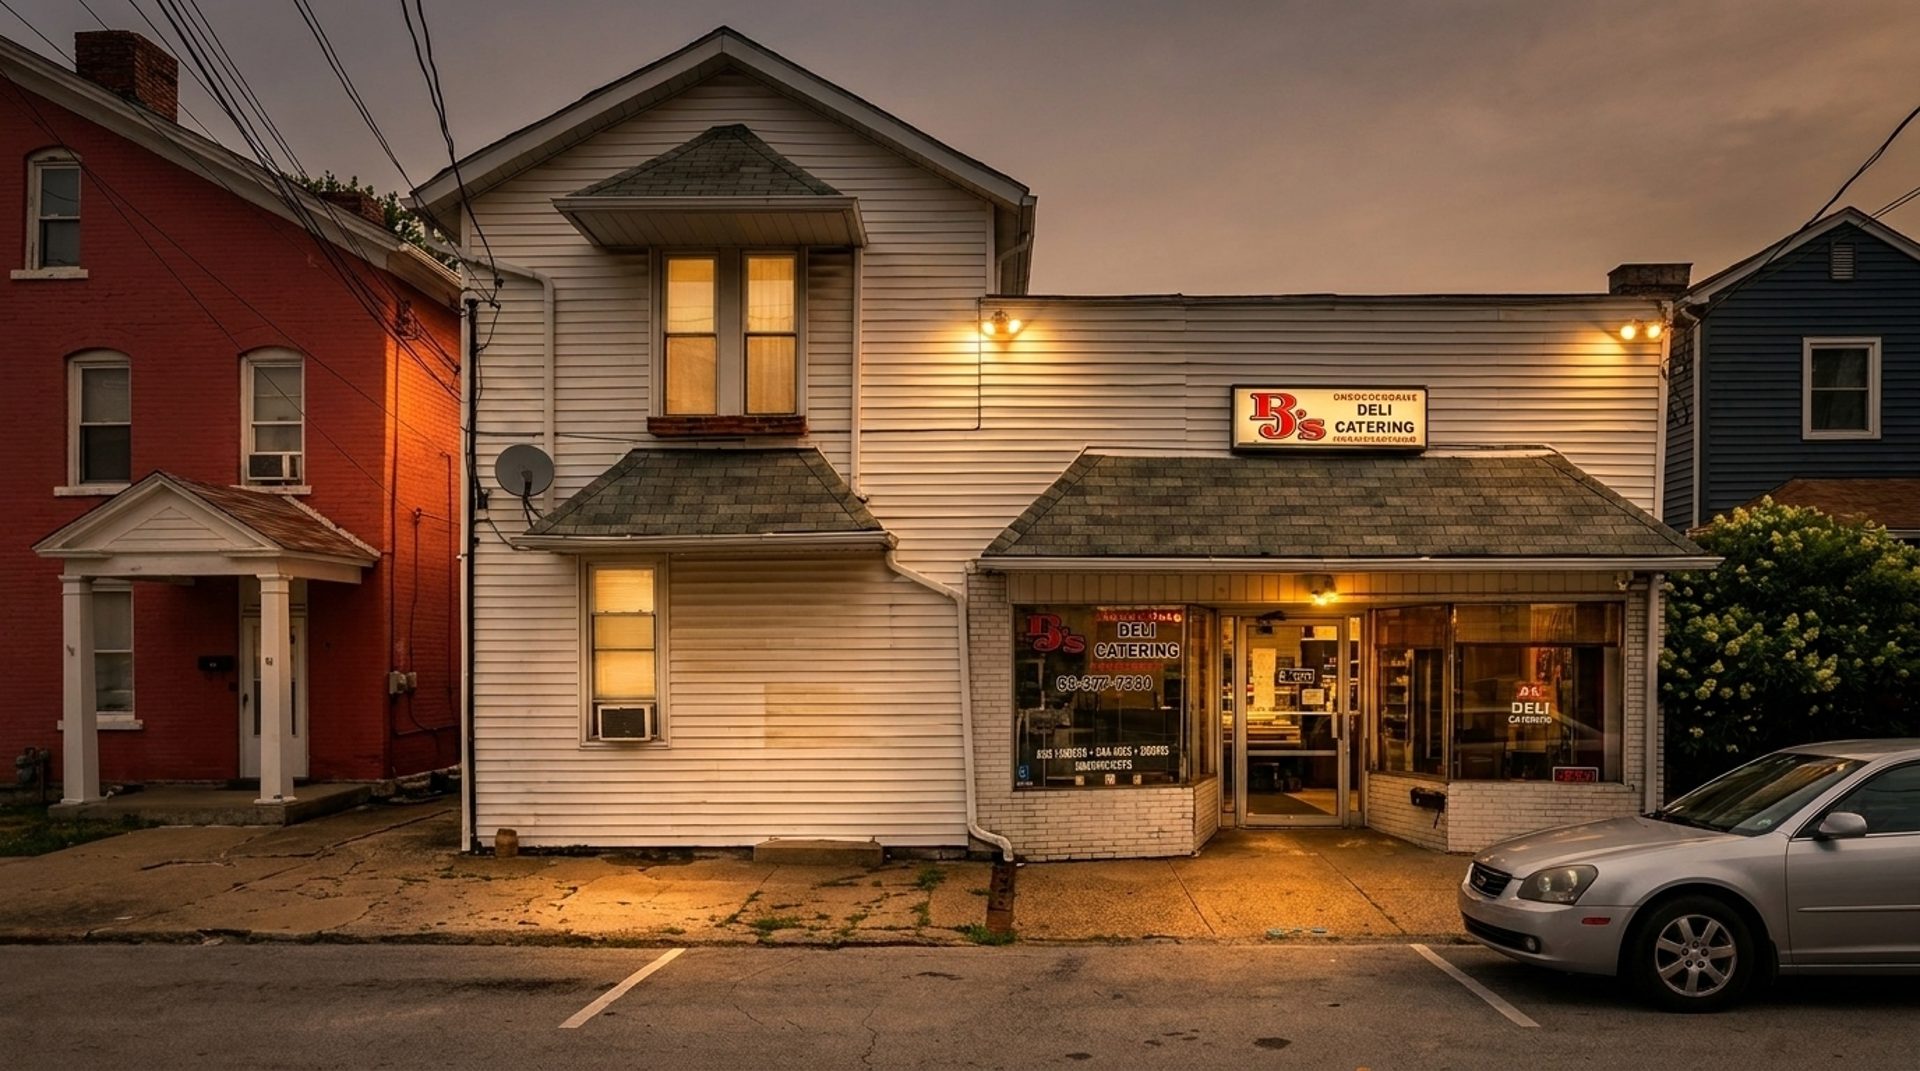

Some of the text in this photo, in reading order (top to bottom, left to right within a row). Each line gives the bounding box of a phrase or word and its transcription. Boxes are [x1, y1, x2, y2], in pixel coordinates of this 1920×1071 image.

[1357, 403, 1392, 416] DELI
[1335, 420, 1415, 433] CATERING
[1117, 621, 1157, 639] DELI
[1094, 642, 1180, 659] CATERING
[1511, 702, 1550, 715] DELI
